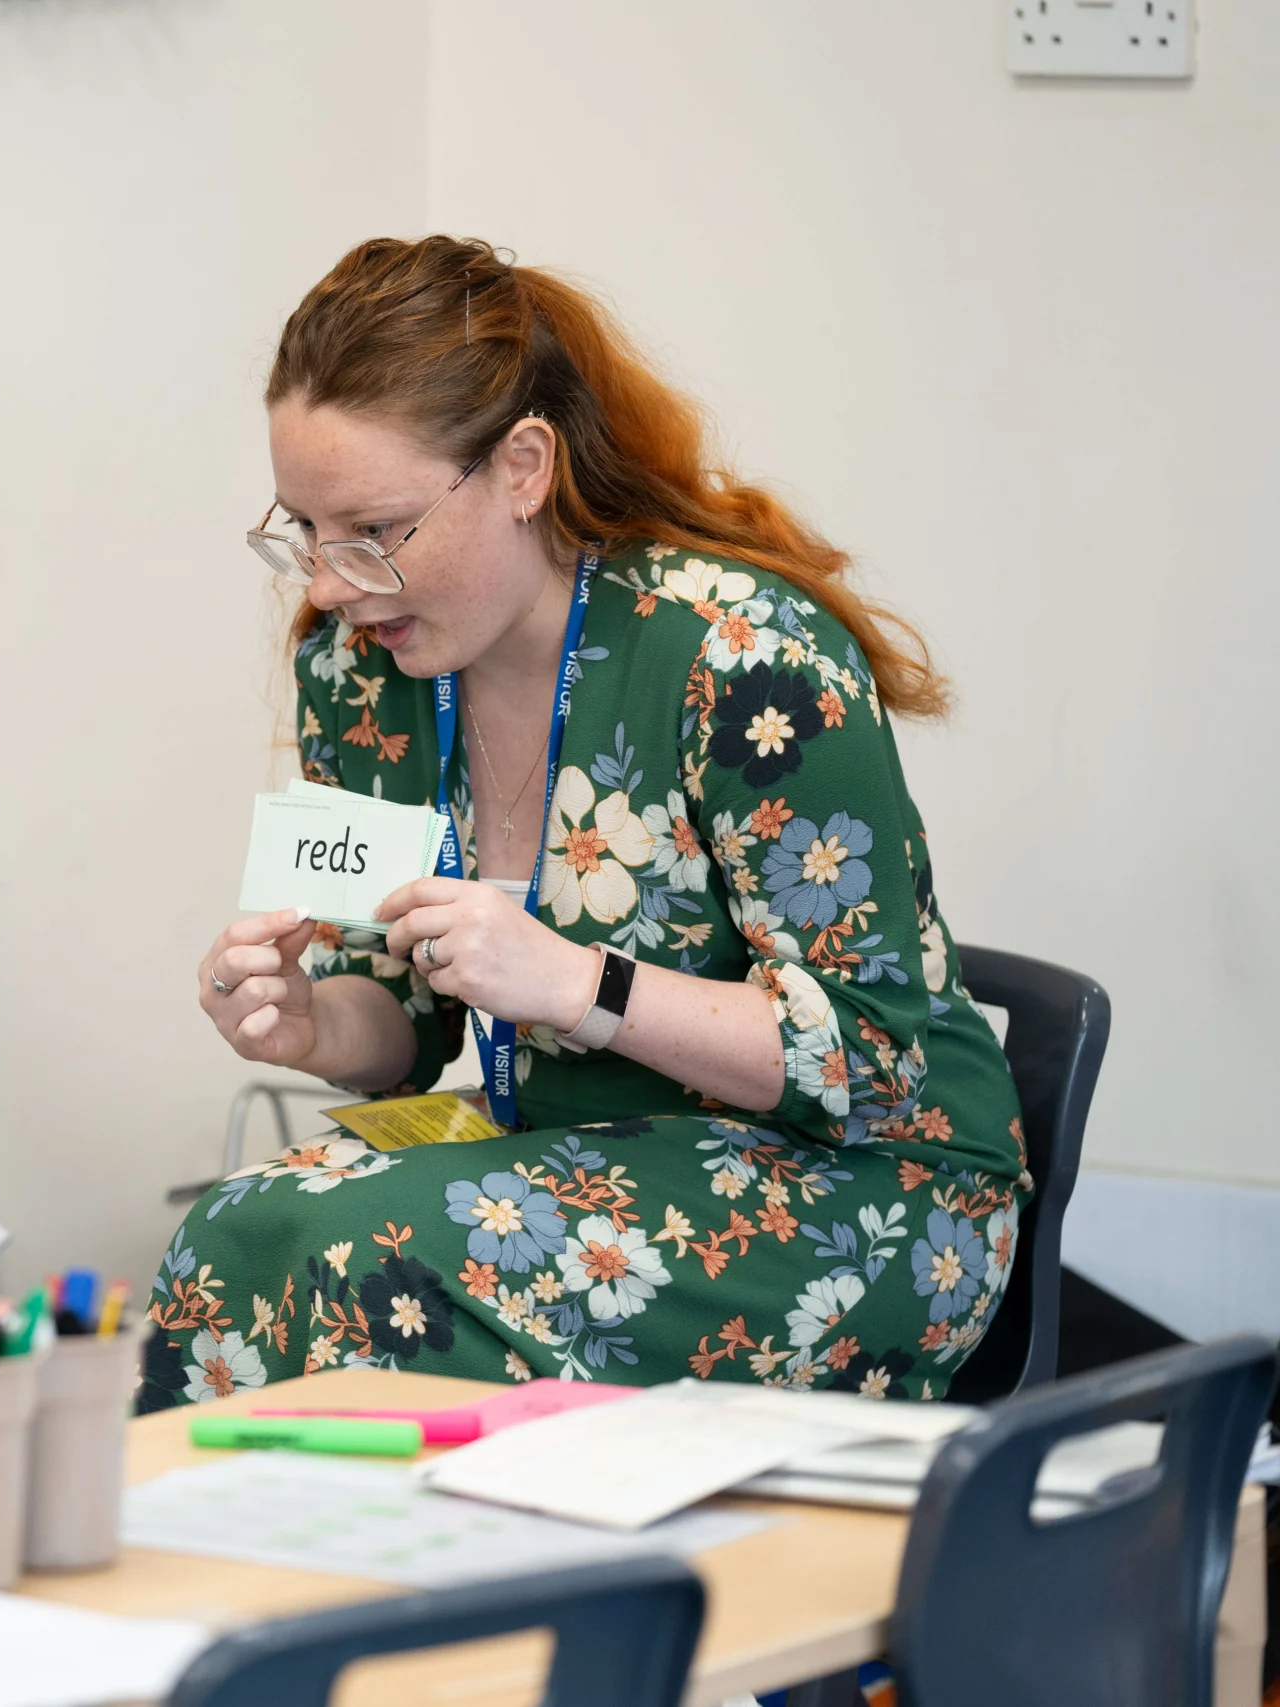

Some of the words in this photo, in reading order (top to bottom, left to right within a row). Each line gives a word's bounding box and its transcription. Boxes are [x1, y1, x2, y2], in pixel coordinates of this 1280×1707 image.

[558, 651, 578, 716] VISITOR
[295, 826, 368, 875] reds
[495, 1045, 510, 1096] VISITOR
